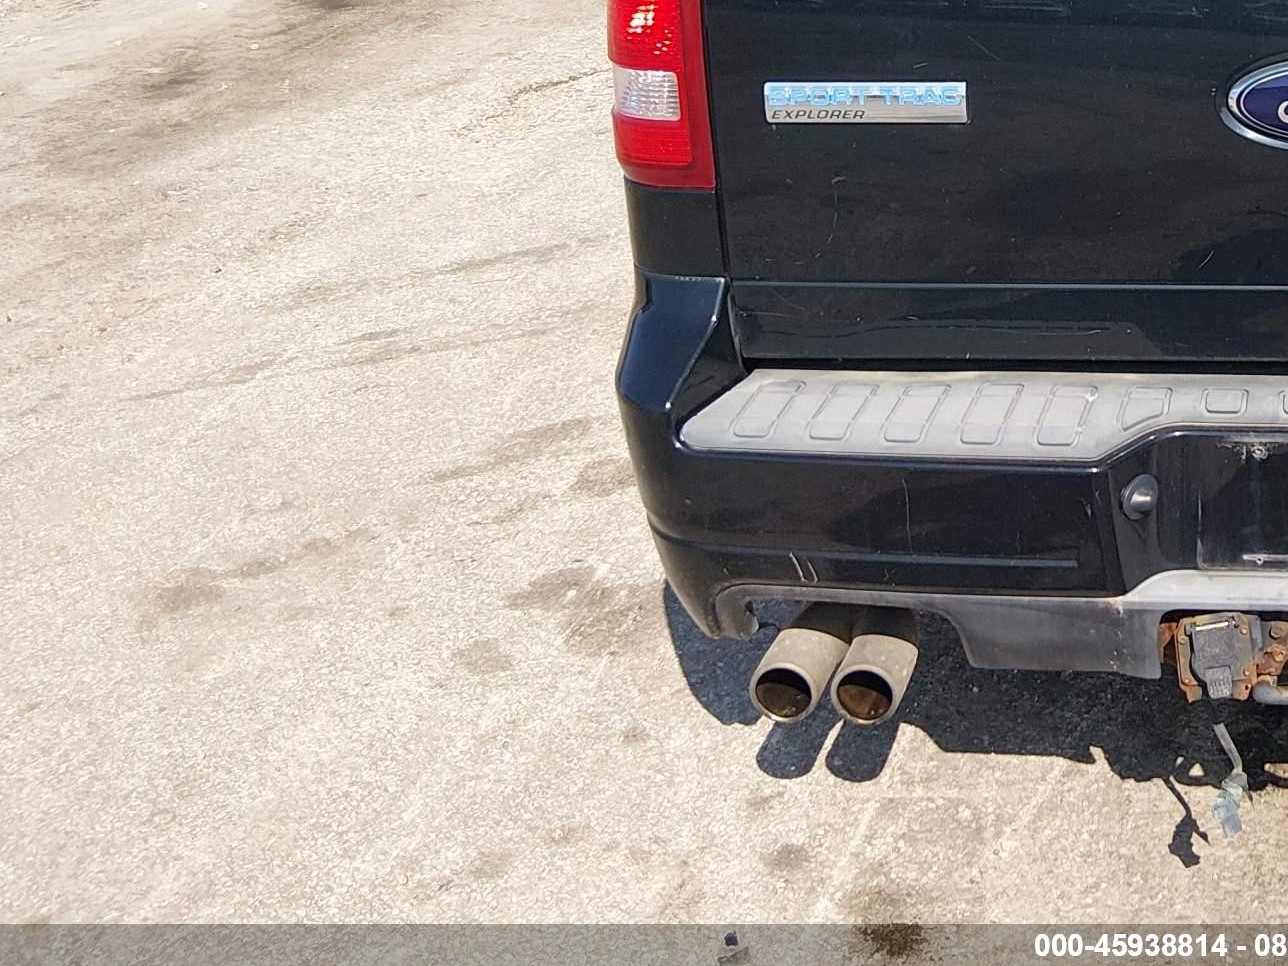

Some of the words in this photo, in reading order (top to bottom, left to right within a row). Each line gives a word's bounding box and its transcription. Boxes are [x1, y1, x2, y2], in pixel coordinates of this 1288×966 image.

[768, 84, 869, 106] SPORT
[879, 84, 962, 106] TRAC
[771, 109, 865, 120] EXPLORER
